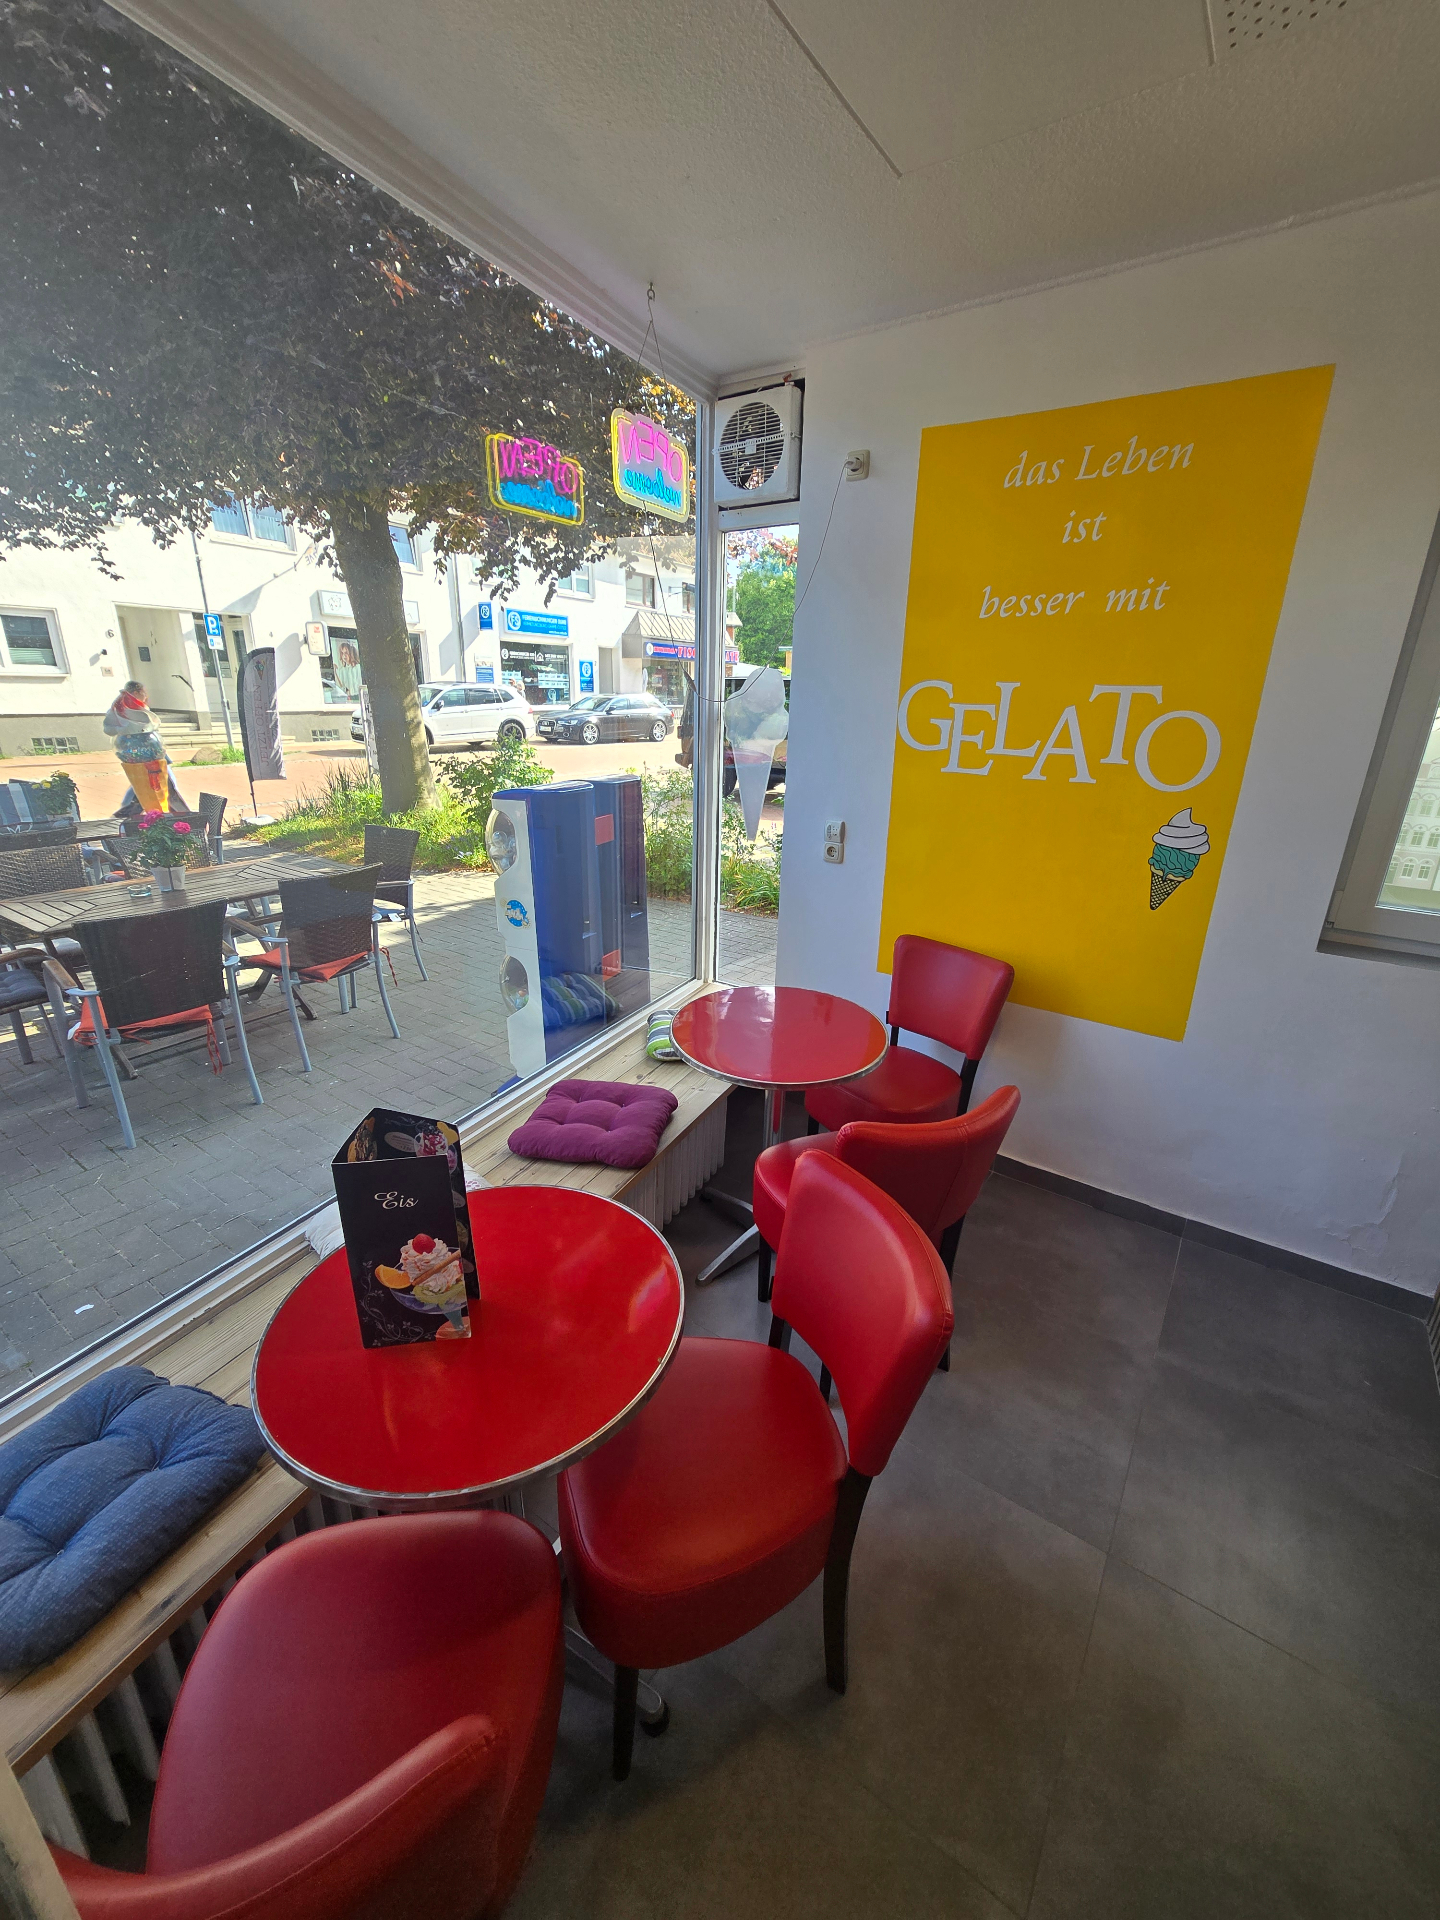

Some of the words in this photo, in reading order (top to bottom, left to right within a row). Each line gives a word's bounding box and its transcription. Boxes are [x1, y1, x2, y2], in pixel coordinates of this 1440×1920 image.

[1003, 450, 1065, 489] das
[1075, 435, 1194, 481] Leben
[1062, 510, 1107, 544] ist
[979, 585, 1085, 619] besser
[1105, 577, 1170, 612] mit
[253, 683, 264, 727] OFFEN
[257, 729, 269, 767] JETZT
[897, 680, 1221, 792] GELATO
[374, 1191, 419, 1209] Eis
